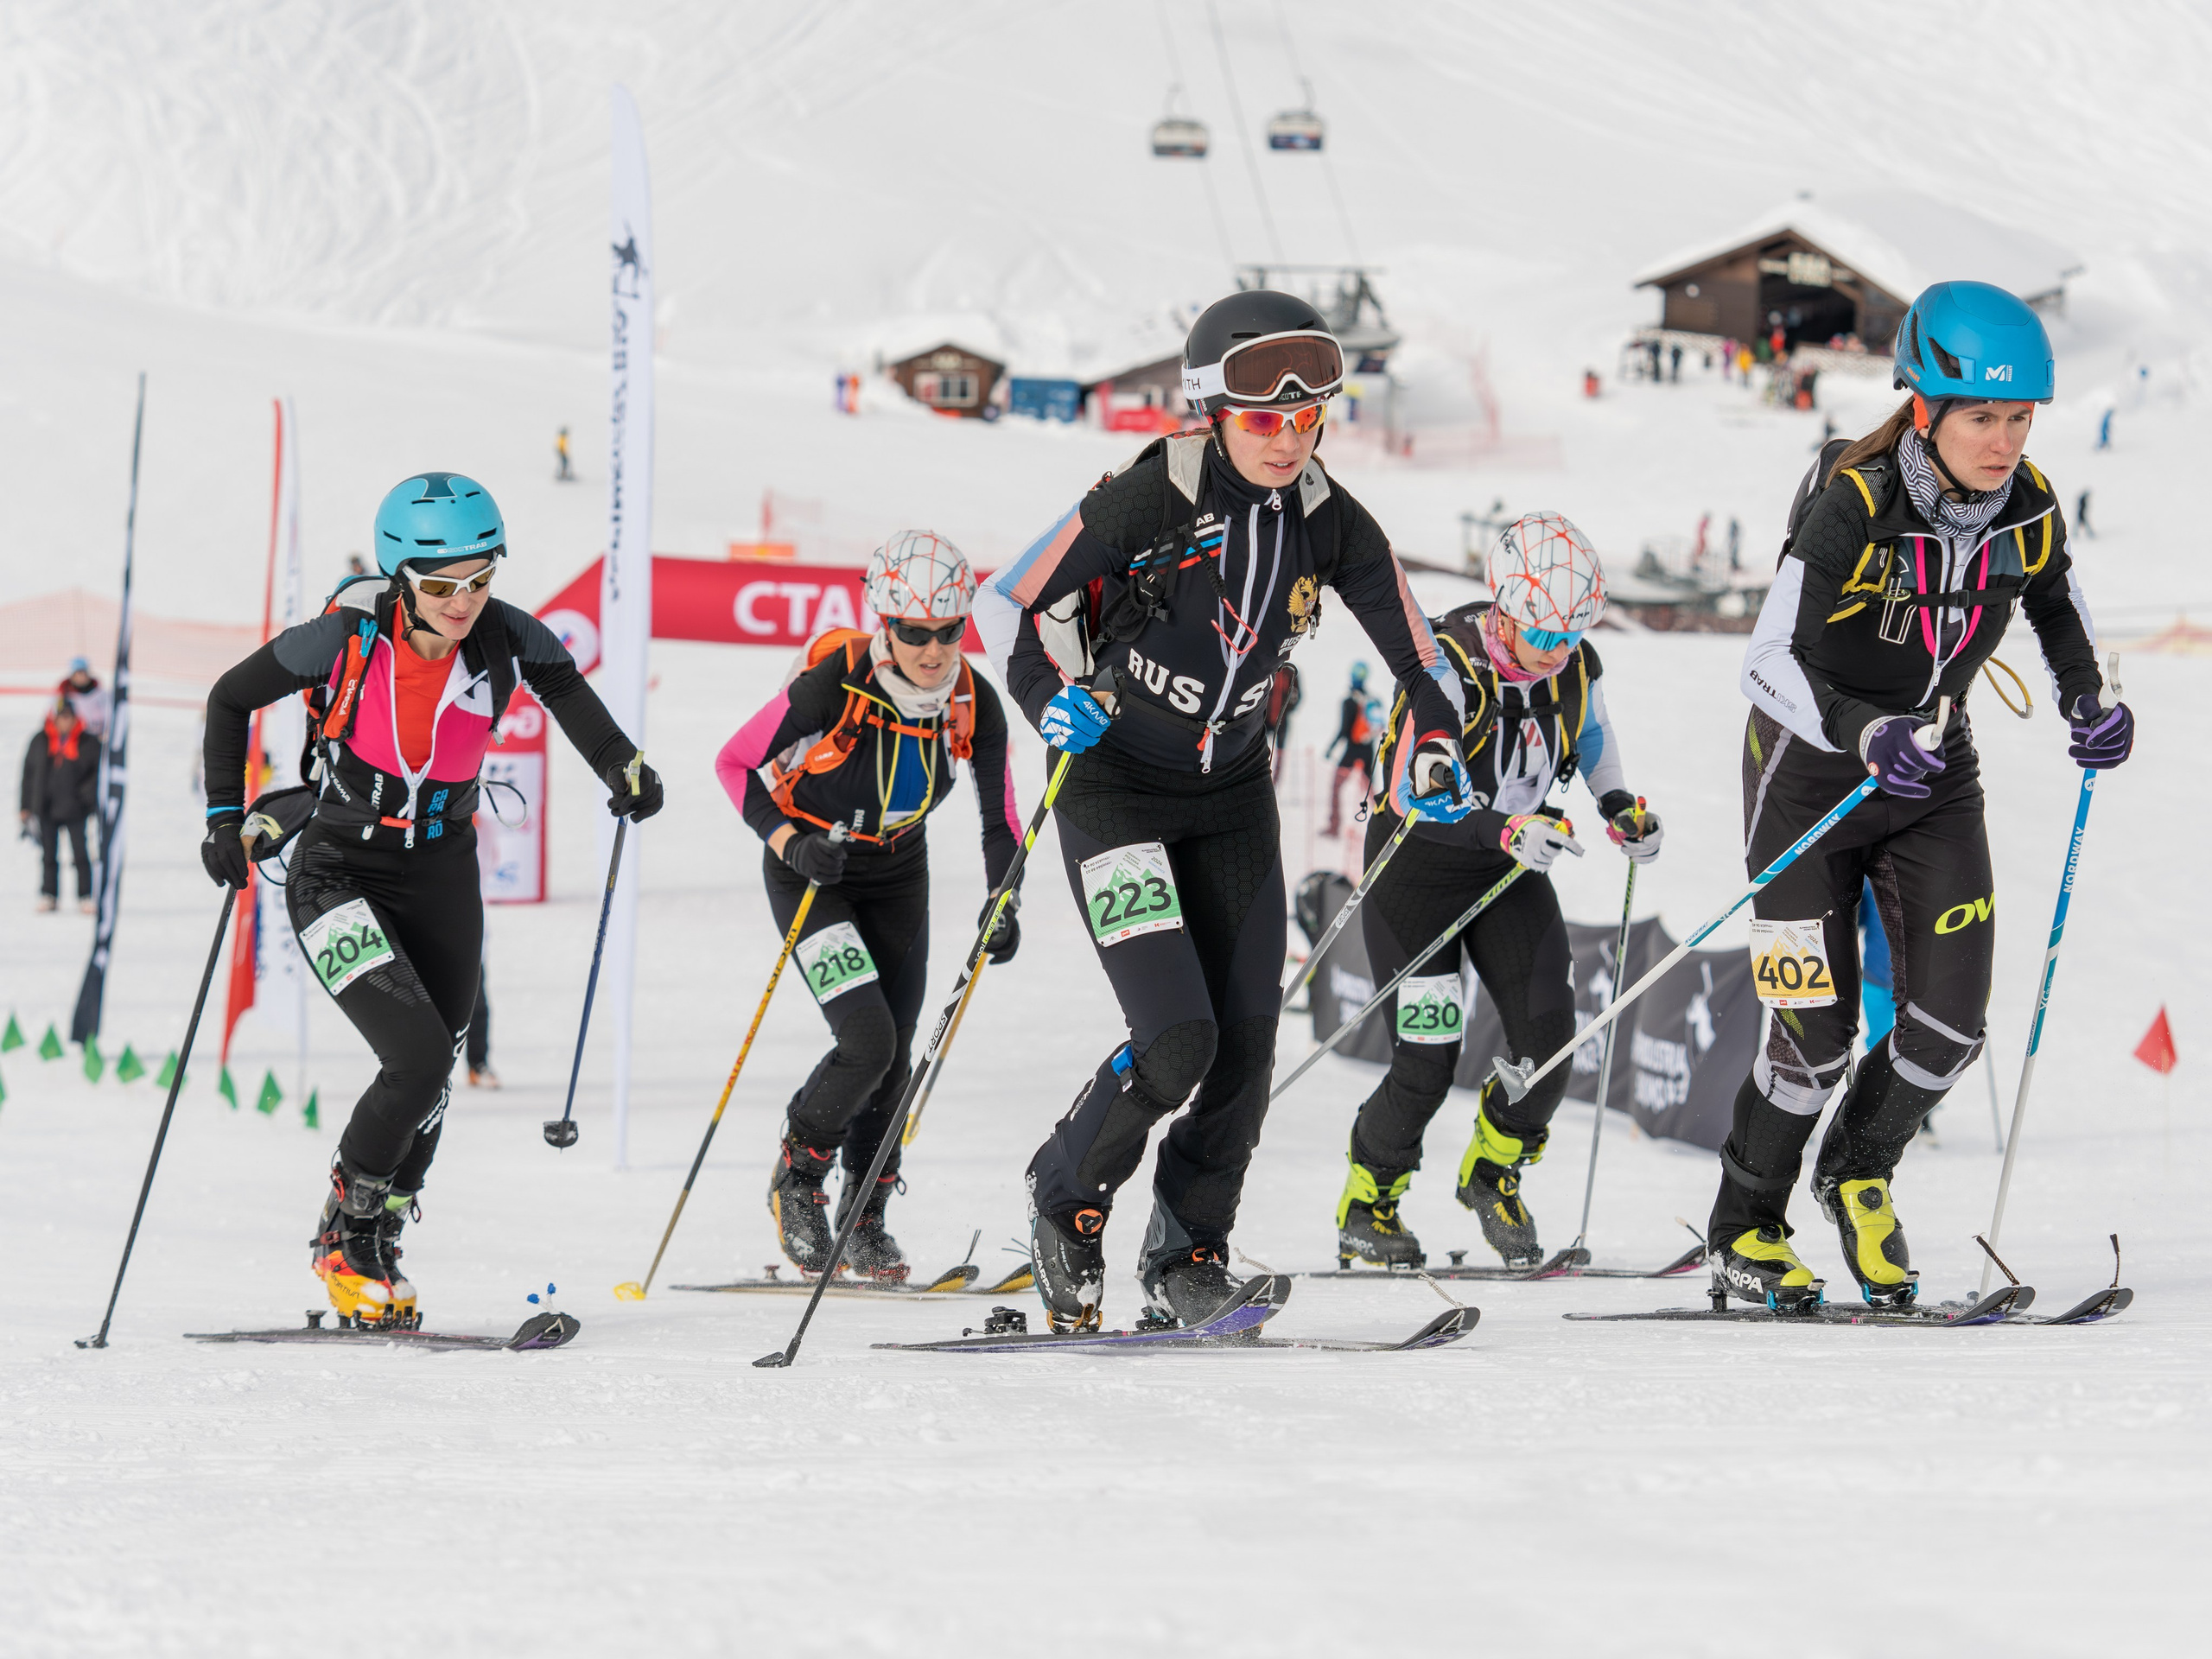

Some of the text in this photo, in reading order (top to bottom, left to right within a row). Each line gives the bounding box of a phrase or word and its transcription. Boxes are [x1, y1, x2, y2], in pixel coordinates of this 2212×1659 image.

[733, 581, 881, 636] СТА
[1561, 610, 1591, 621] CAMP
[1749, 670, 1798, 714] SKITRAB
[1795, 814, 1841, 855] NORDWAY
[1151, 856, 1163, 866] 2024
[2063, 827, 2085, 893] NORDWAY
[1095, 877, 1172, 928] 223
[317, 925, 383, 980] 204
[1807, 934, 1819, 944] 2024
[812, 947, 865, 988] 218
[1758, 956, 1830, 990] 402
[928, 1013, 948, 1053] SPORT
[1402, 1002, 1459, 1029] 230
[1033, 1238, 1054, 1299] SCARPA
